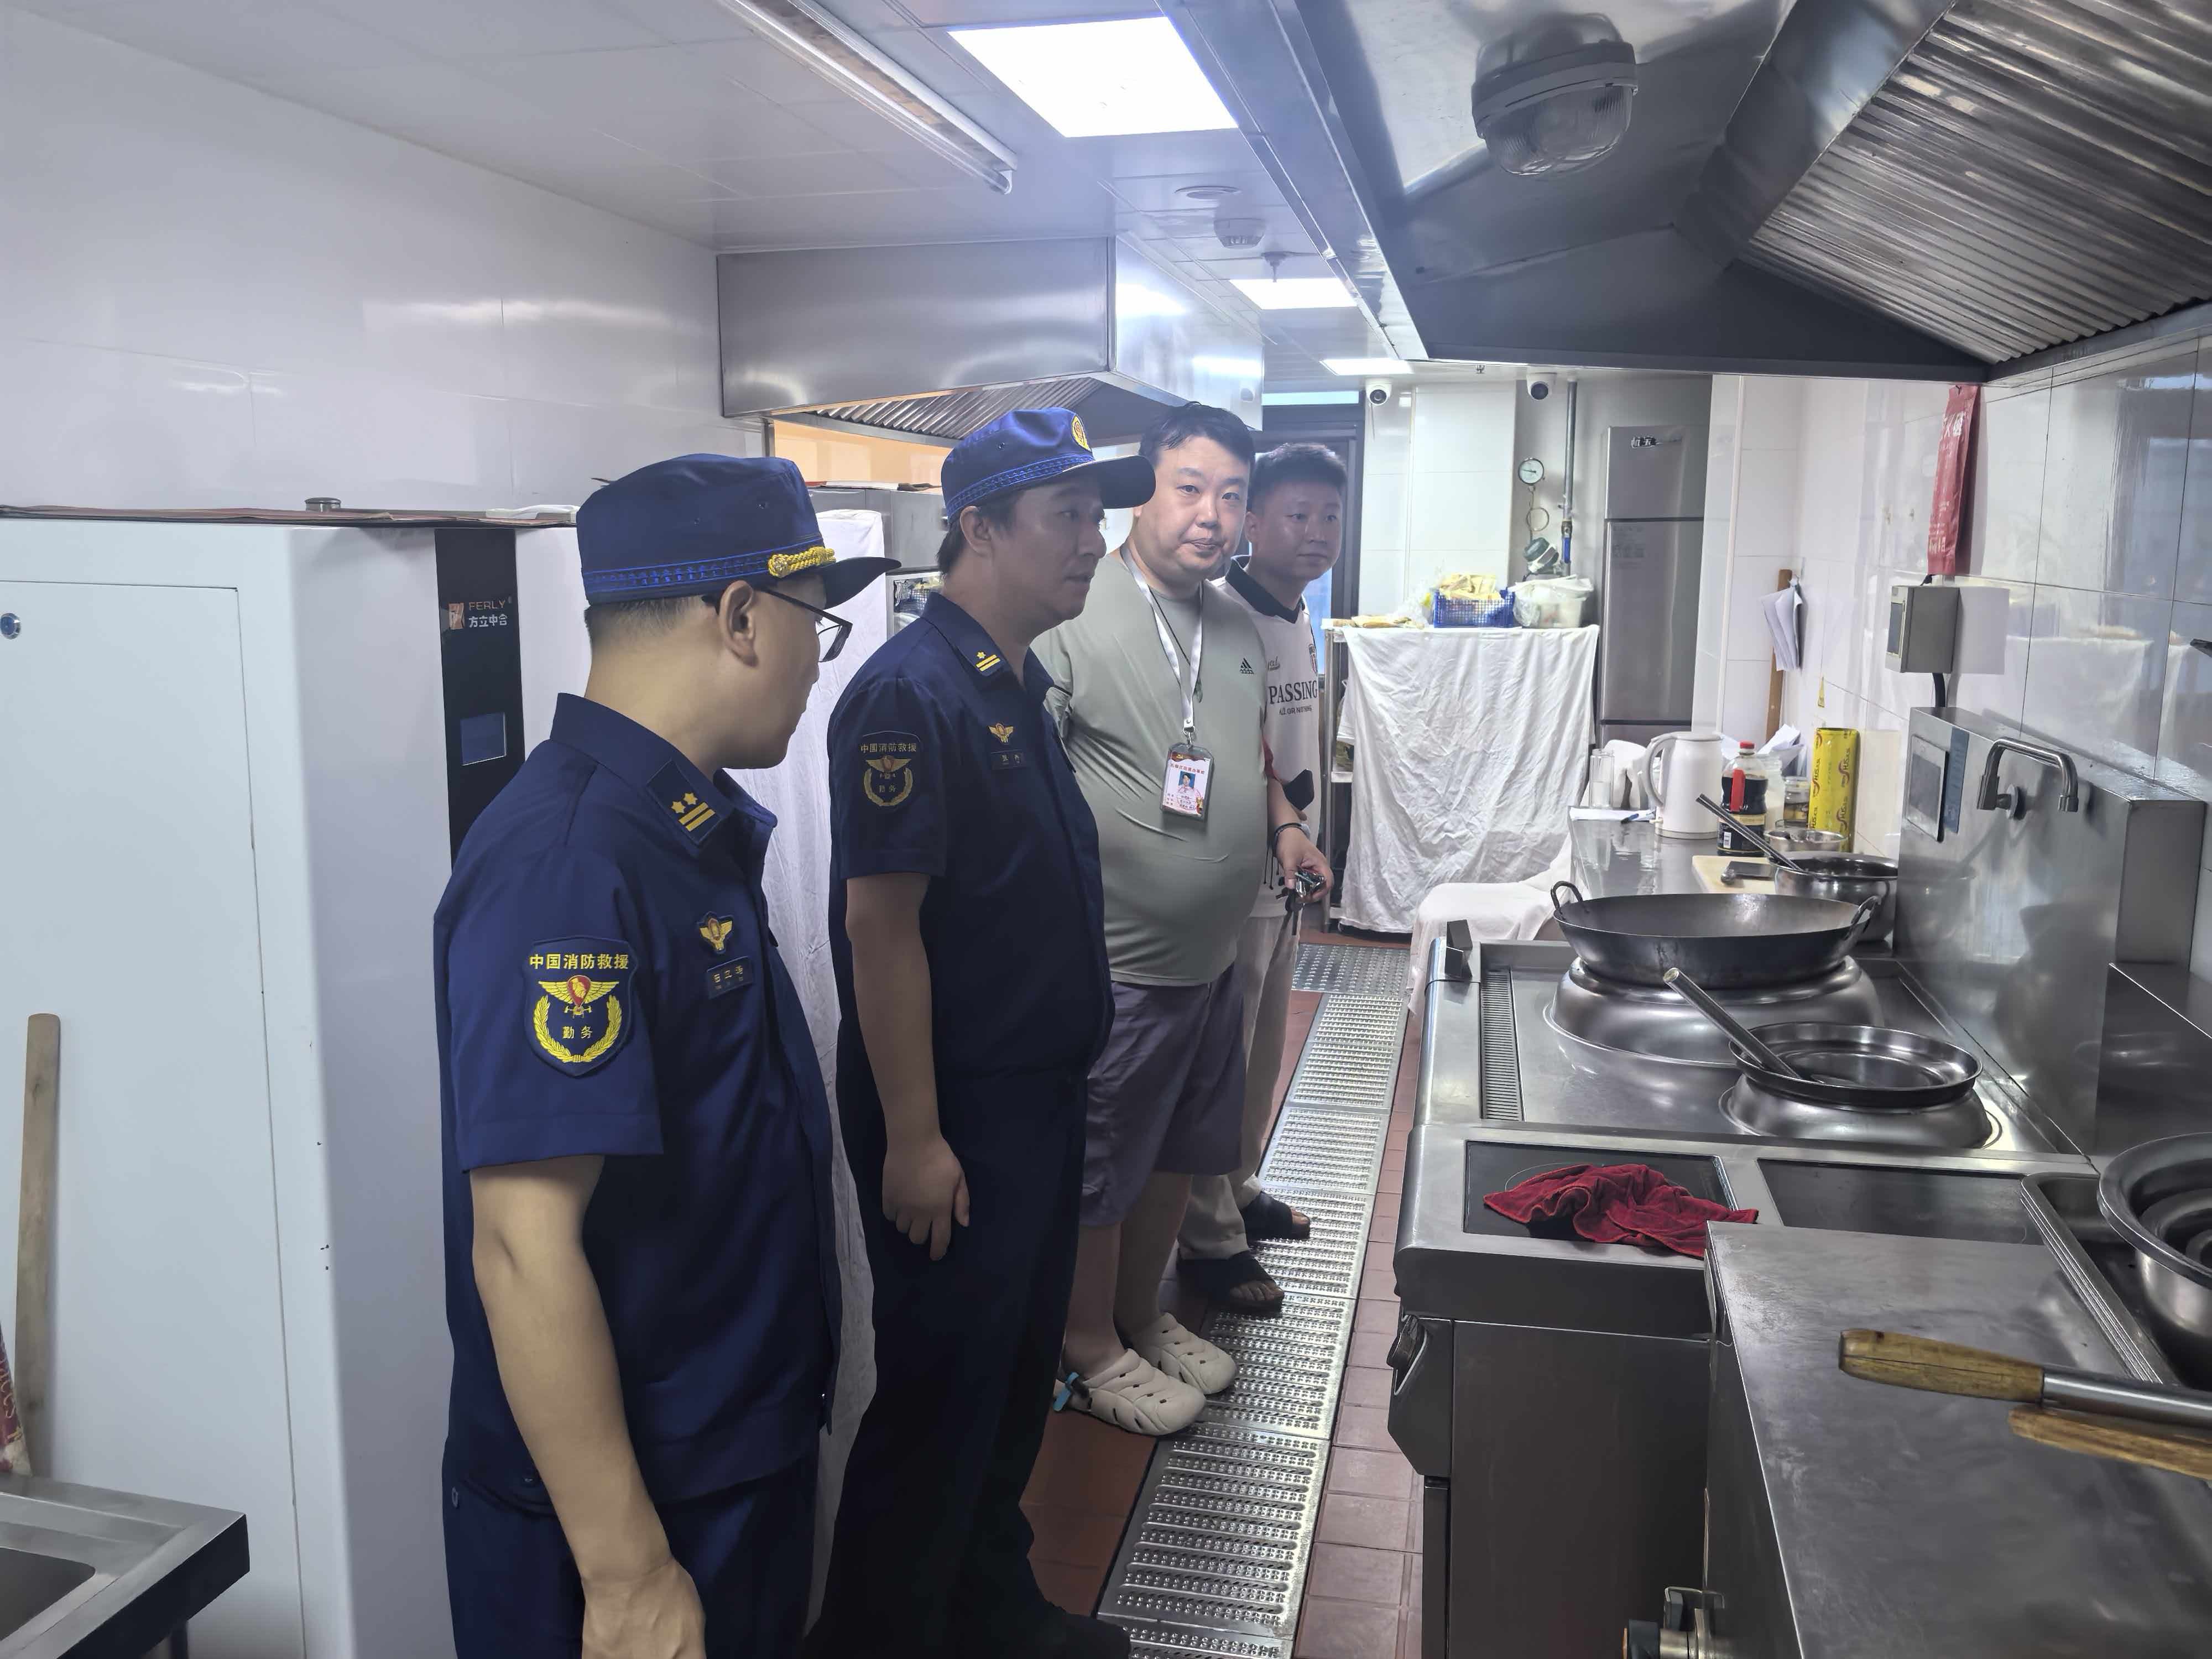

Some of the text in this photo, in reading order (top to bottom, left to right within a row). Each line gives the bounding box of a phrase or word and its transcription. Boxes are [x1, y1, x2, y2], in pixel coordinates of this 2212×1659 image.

[468, 600, 505, 611] FERLY
[468, 614, 508, 628] 方立中合
[1268, 680, 1318, 705] PASSING
[860, 743, 916, 753] 中国消防救援
[529, 953, 629, 970] 中国消防救援
[561, 1025, 593, 1040] 勤务
